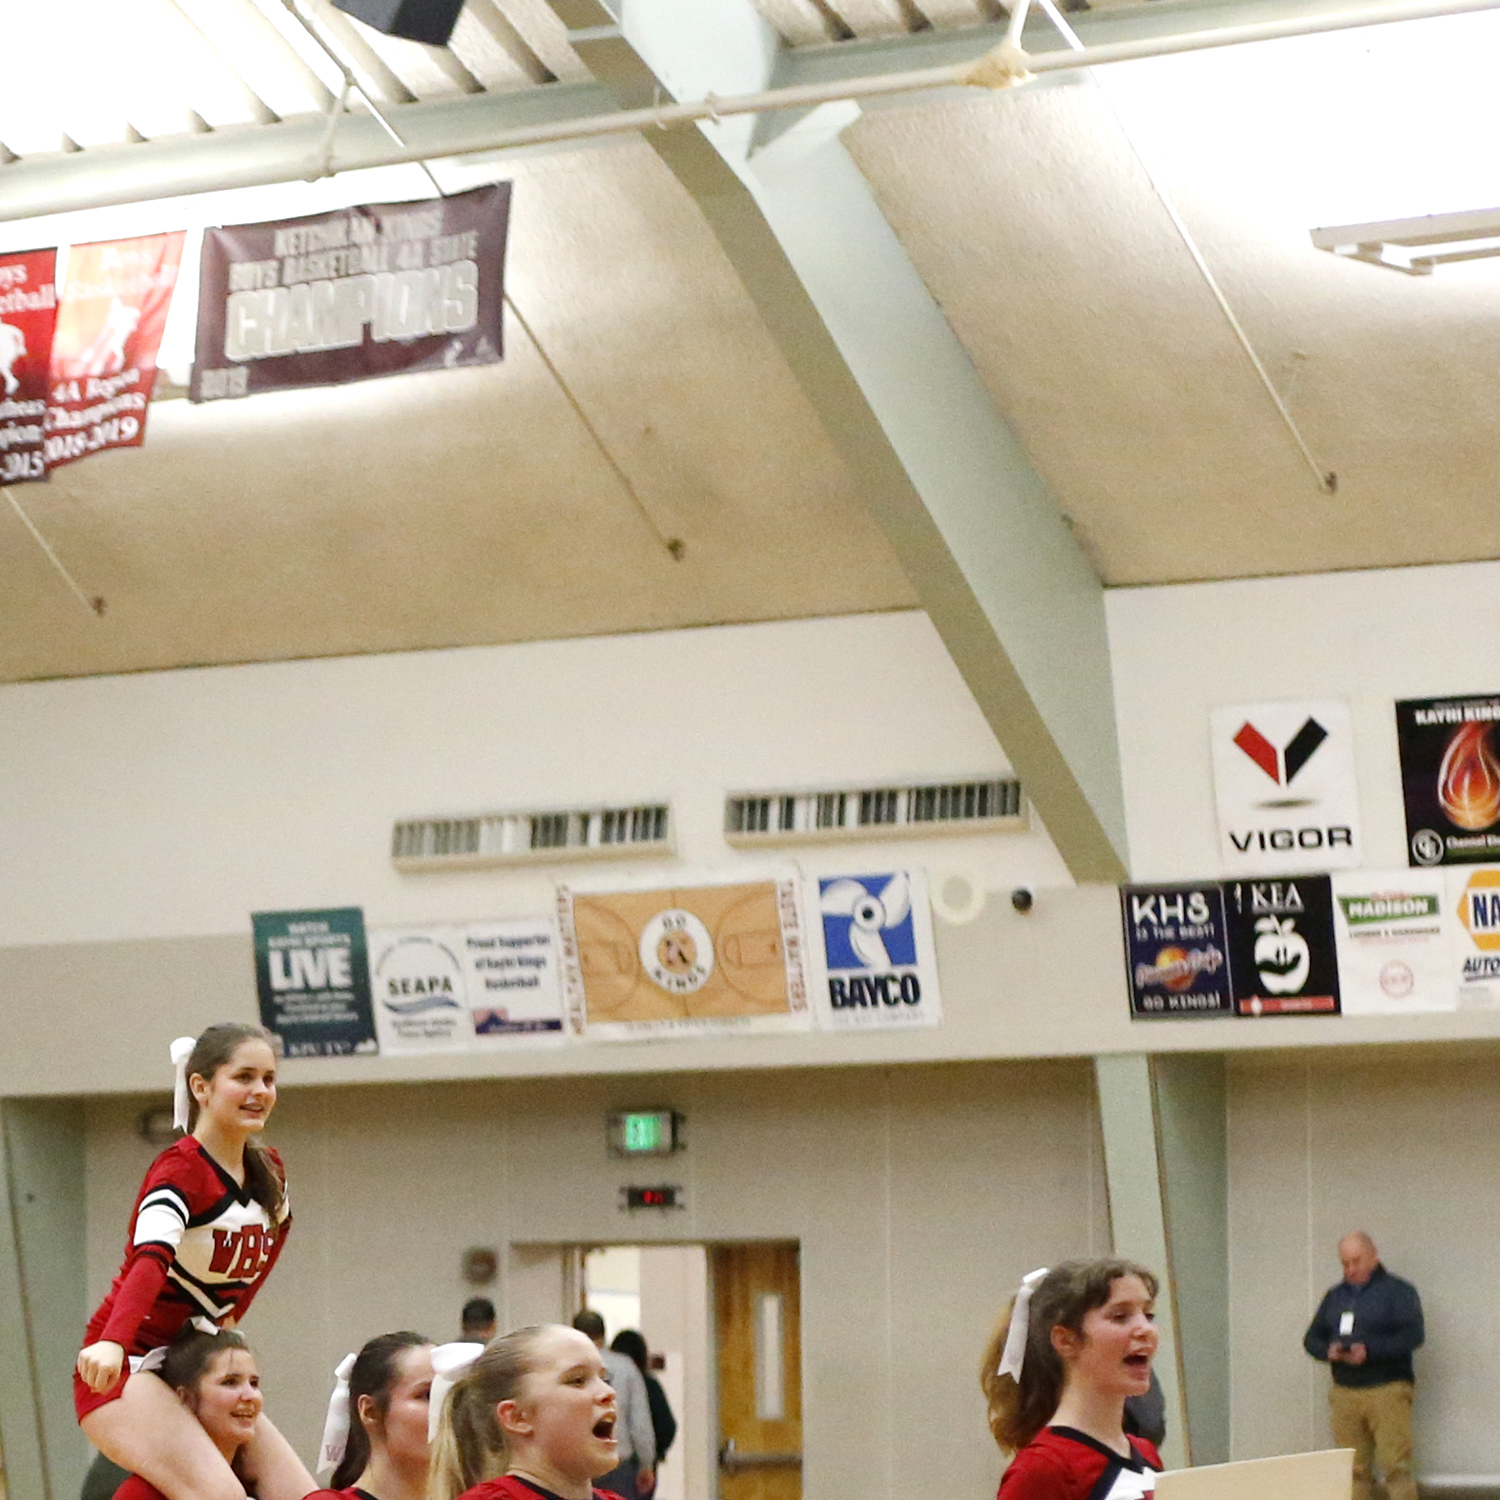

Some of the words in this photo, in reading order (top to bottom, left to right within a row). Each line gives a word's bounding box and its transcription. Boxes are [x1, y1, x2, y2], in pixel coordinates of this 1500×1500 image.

[224, 259, 479, 362] CHAMPIONS
[1229, 826, 1352, 853] VIGOR
[1132, 891, 1210, 925] KHS
[1252, 882, 1303, 909] KEA
[1349, 897, 1429, 918] MADISON
[268, 947, 354, 990] LIVE
[388, 975, 454, 996] SEAPA
[828, 972, 921, 1011] BAYCO
